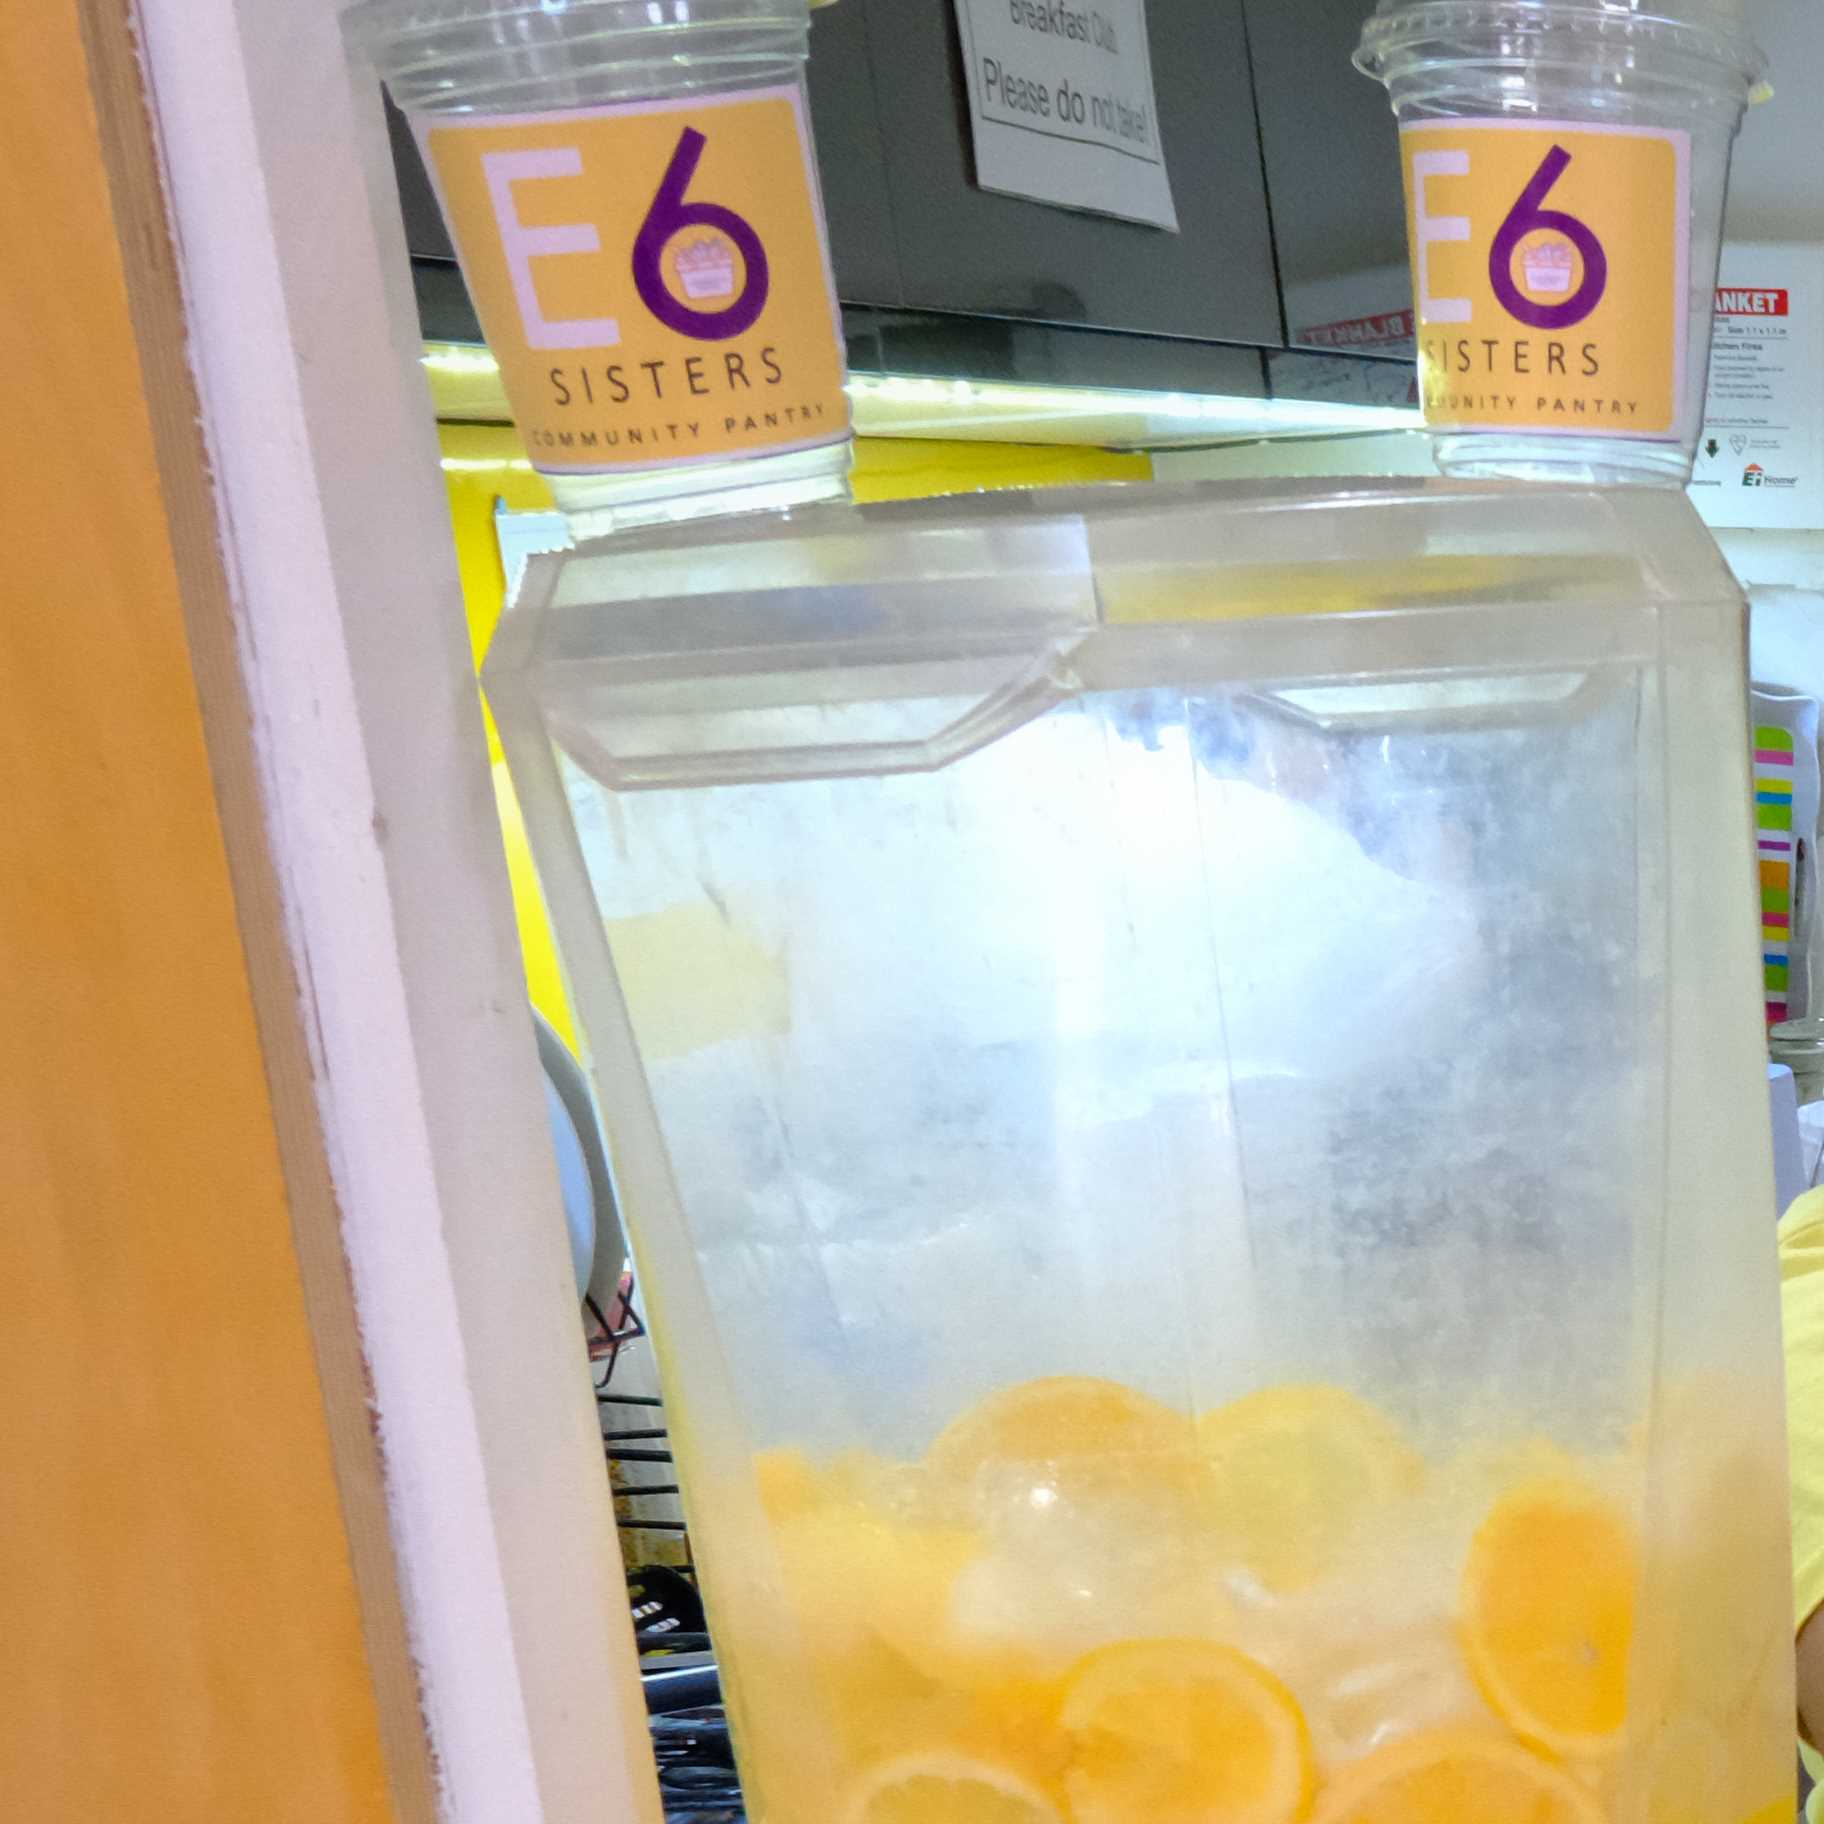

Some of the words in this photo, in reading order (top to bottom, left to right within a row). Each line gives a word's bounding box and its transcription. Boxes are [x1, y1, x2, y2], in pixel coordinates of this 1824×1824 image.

[983, 57, 1051, 118] Please
[1056, 78, 1086, 125] do
[482, 126, 770, 350] E6
[1413, 145, 1608, 330] E6
[550, 346, 785, 406] SISTERS
[1537, 396, 1638, 415] PANTRY
[530, 420, 701, 449] COMMUNITY
[723, 402, 826, 433] PANTRY
